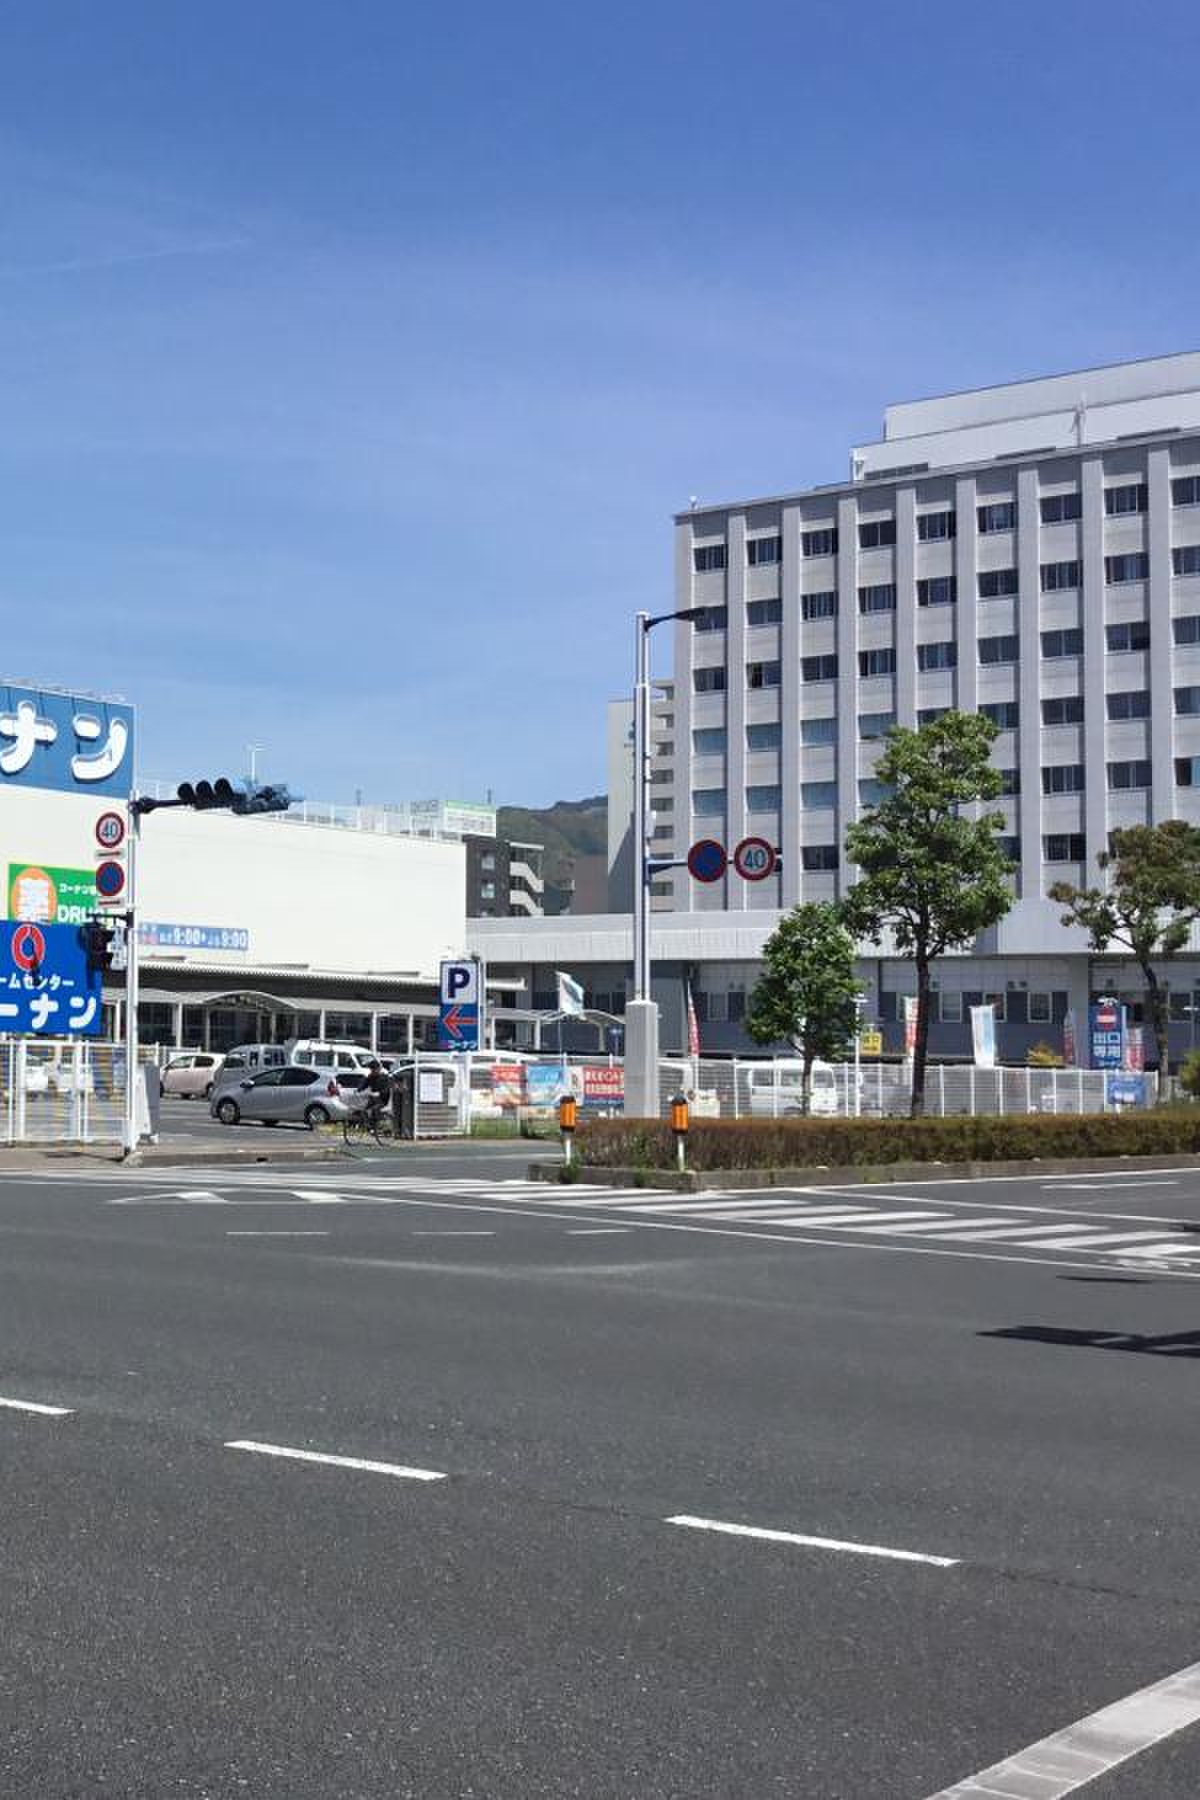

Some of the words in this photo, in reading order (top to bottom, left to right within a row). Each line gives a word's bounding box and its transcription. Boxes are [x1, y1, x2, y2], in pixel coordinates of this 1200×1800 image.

[101, 821, 119, 839] 40
[744, 848, 767, 869] 40
[448, 967, 471, 998] P
